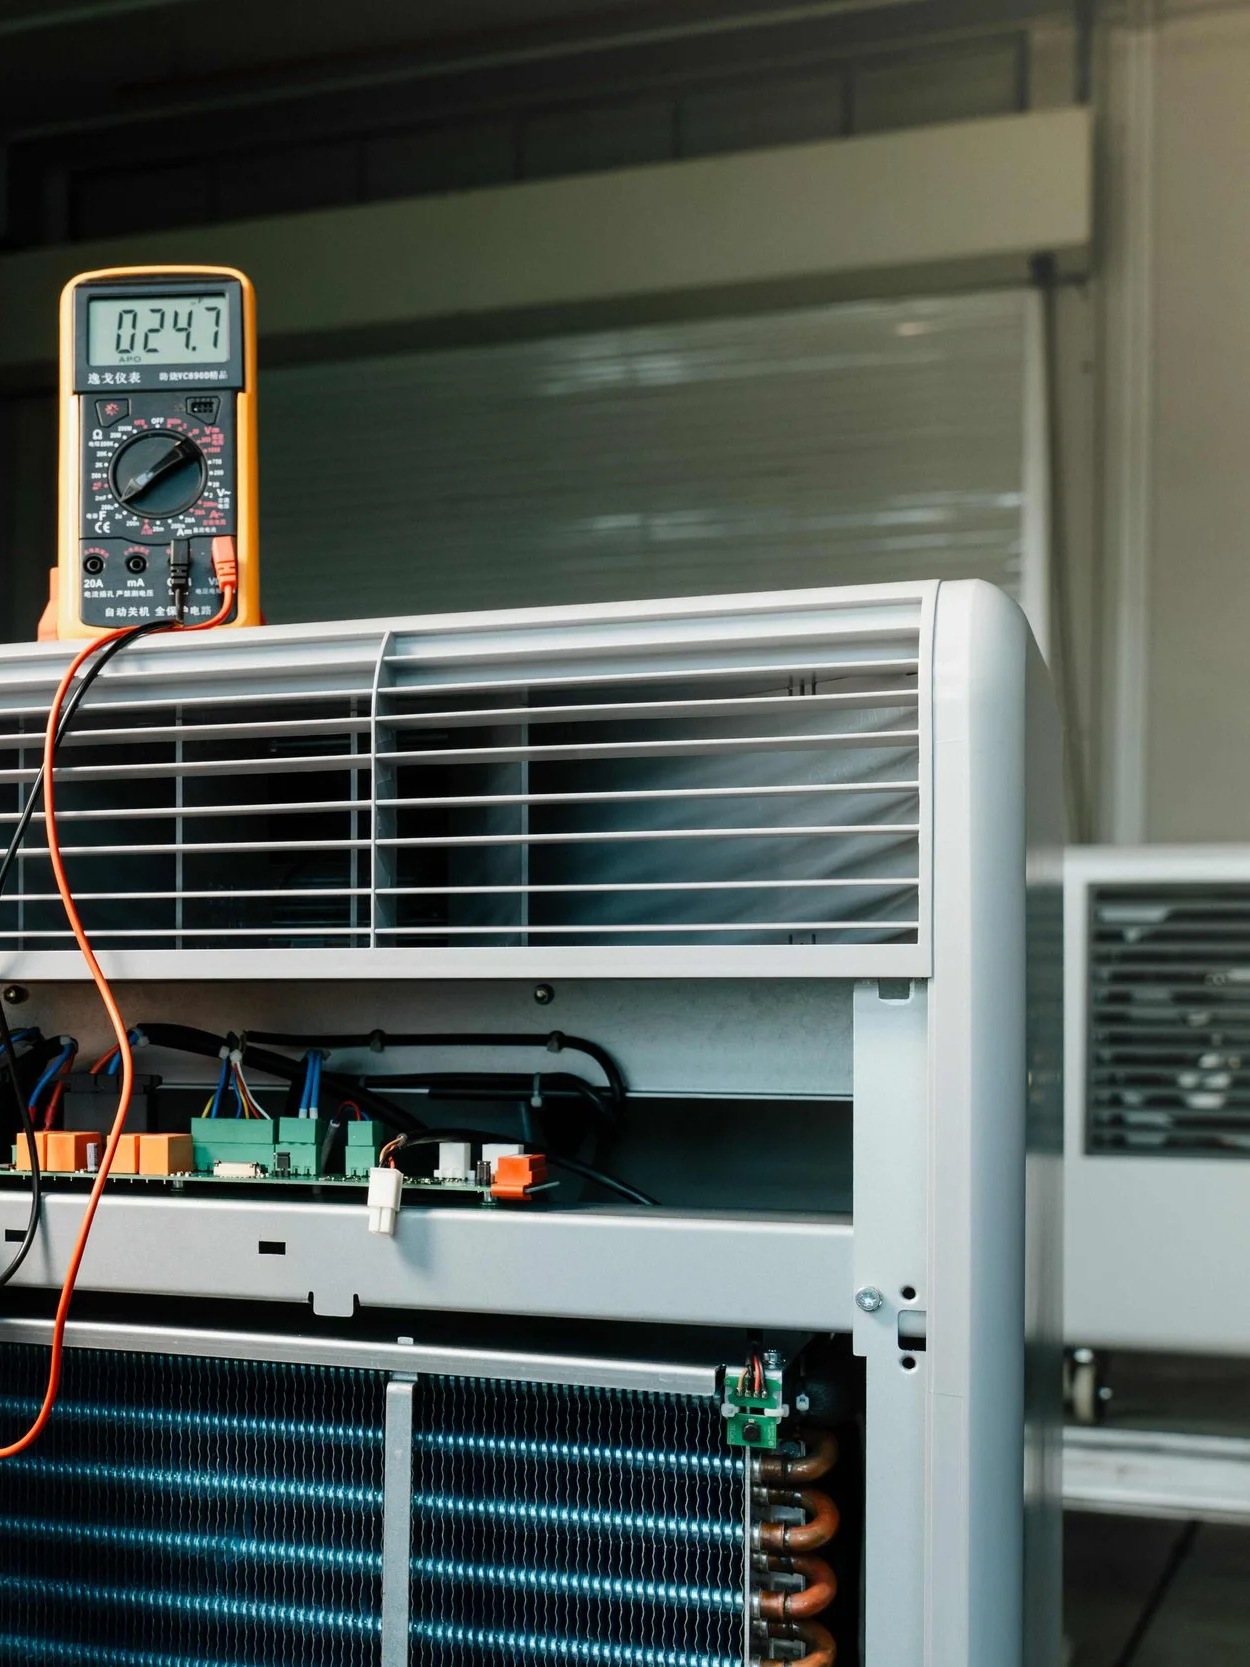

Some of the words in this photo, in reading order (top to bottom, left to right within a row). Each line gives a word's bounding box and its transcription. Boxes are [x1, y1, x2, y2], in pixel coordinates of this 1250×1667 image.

[115, 306, 221, 354] 024.7
[94, 521, 111, 533] CE
[83, 578, 104, 588] 20A
[126, 578, 145, 587] mA
[105, 606, 150, 617] 自动关机
